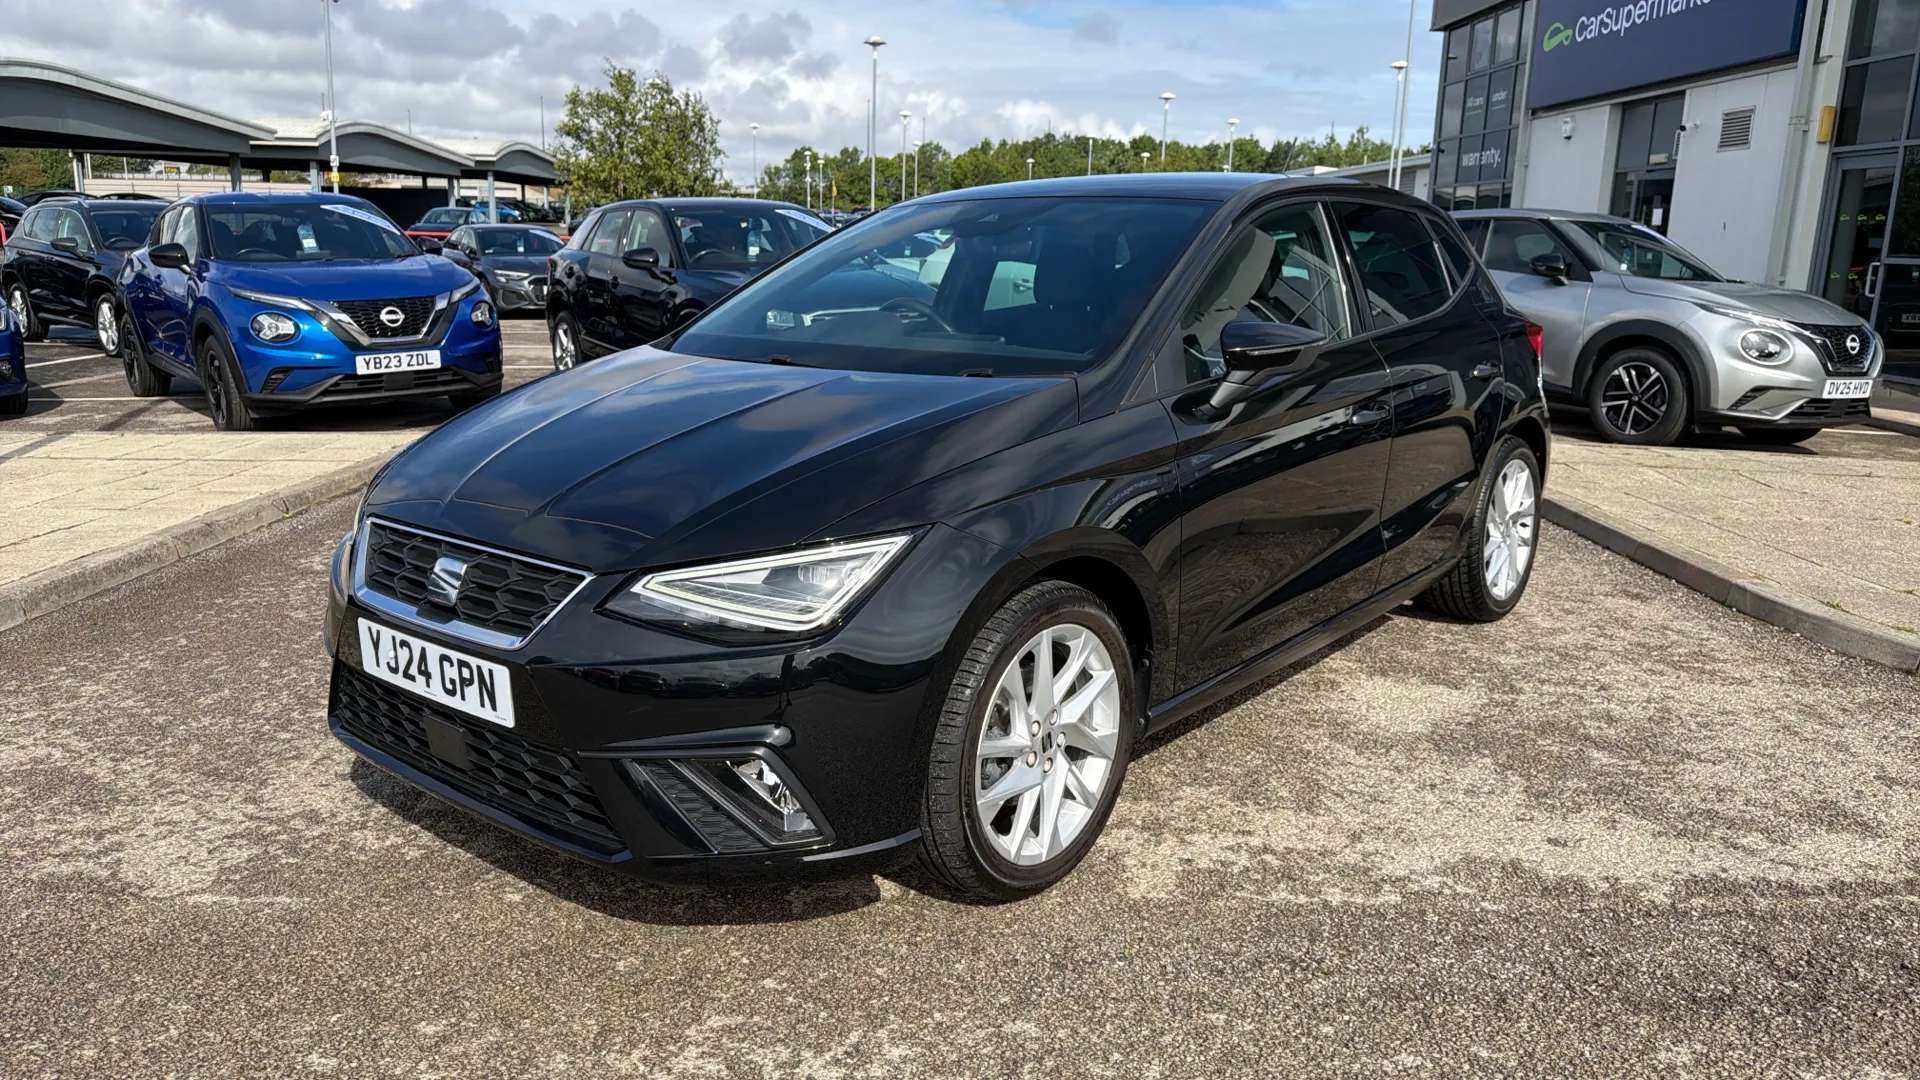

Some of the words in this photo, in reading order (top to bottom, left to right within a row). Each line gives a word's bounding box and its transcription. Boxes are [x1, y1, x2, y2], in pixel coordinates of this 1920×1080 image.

[1575, 0, 1711, 42] CarSuperma
[363, 355, 402, 370] YB23
[406, 353, 434, 367] ZDL
[1828, 382, 1852, 395] DV25
[1853, 381, 1869, 395] HVD
[368, 626, 432, 688] YJ24
[438, 653, 497, 712] GPN
